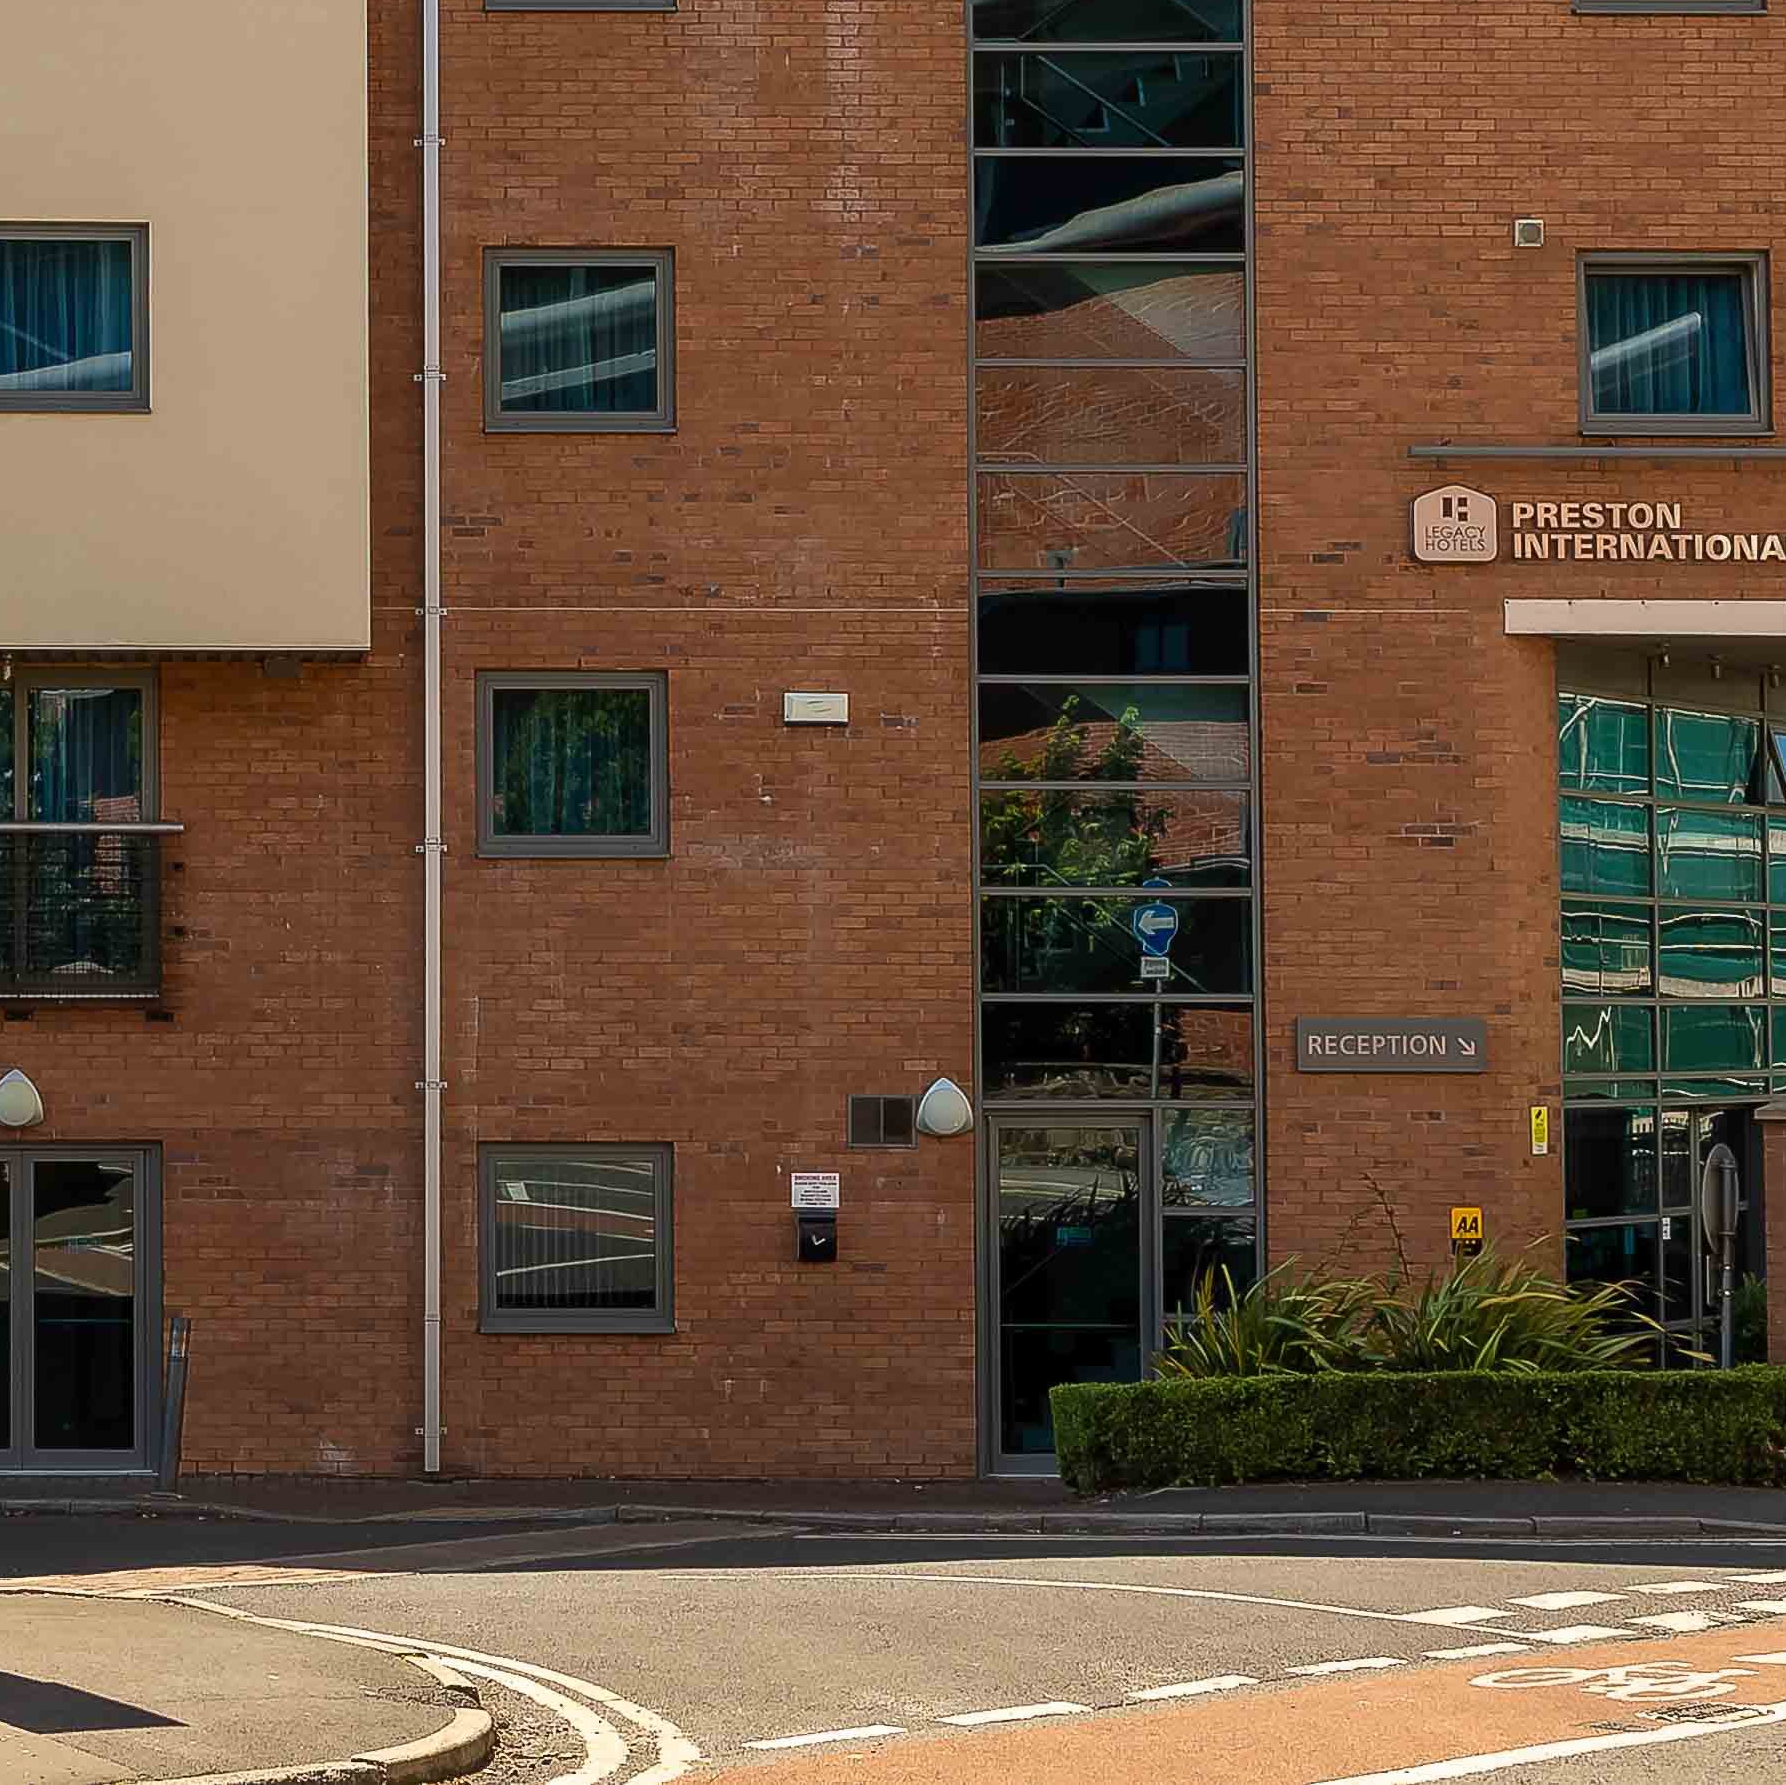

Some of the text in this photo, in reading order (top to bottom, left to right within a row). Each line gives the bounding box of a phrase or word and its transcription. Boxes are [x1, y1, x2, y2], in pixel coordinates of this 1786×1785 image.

[1512, 502, 1681, 529] PRESTON
[1425, 525, 1486, 539] LEGACY
[1425, 539, 1486, 551] HOTELS
[1308, 1035, 1446, 1055] RECEPTION
[1456, 1216, 1479, 1232] AA
